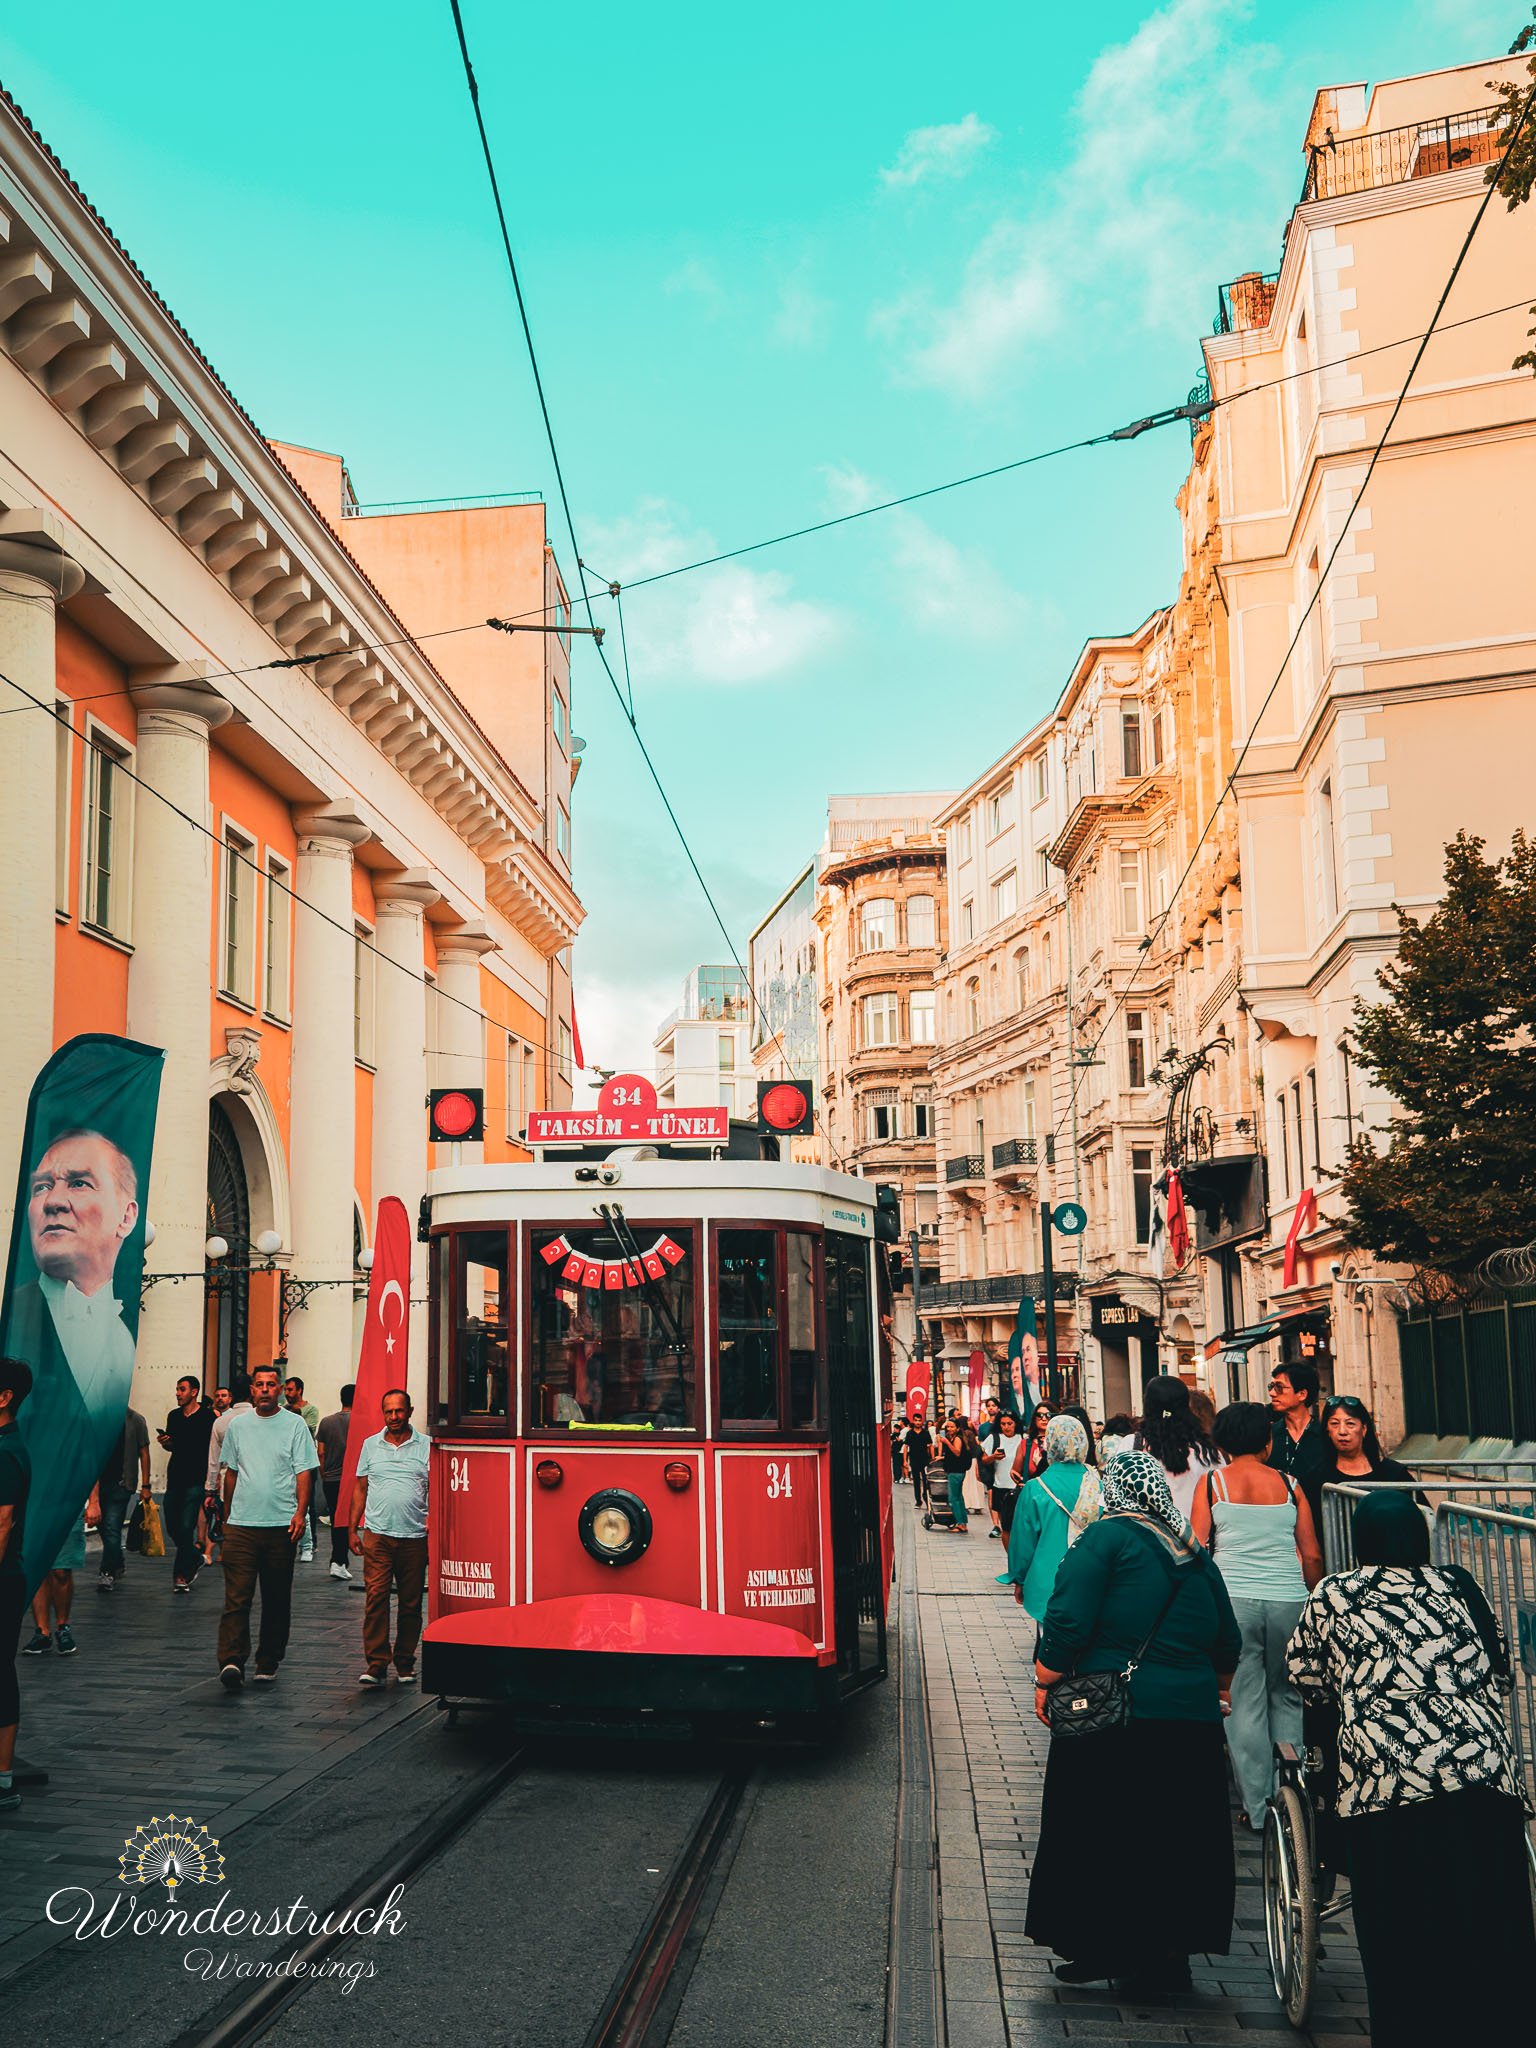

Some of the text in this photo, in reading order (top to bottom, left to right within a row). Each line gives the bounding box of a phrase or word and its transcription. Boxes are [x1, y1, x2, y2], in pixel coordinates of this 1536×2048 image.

[612, 1087, 642, 1106] 34
[537, 1113, 622, 1136] TAKSİM
[647, 1113, 720, 1135] TÜNEL
[451, 1456, 470, 1491] 34
[766, 1462, 793, 1499] 34
[464, 1561, 492, 1579] YASAK
[790, 1567, 814, 1586] YASAK
[743, 1590, 757, 1607] VE
